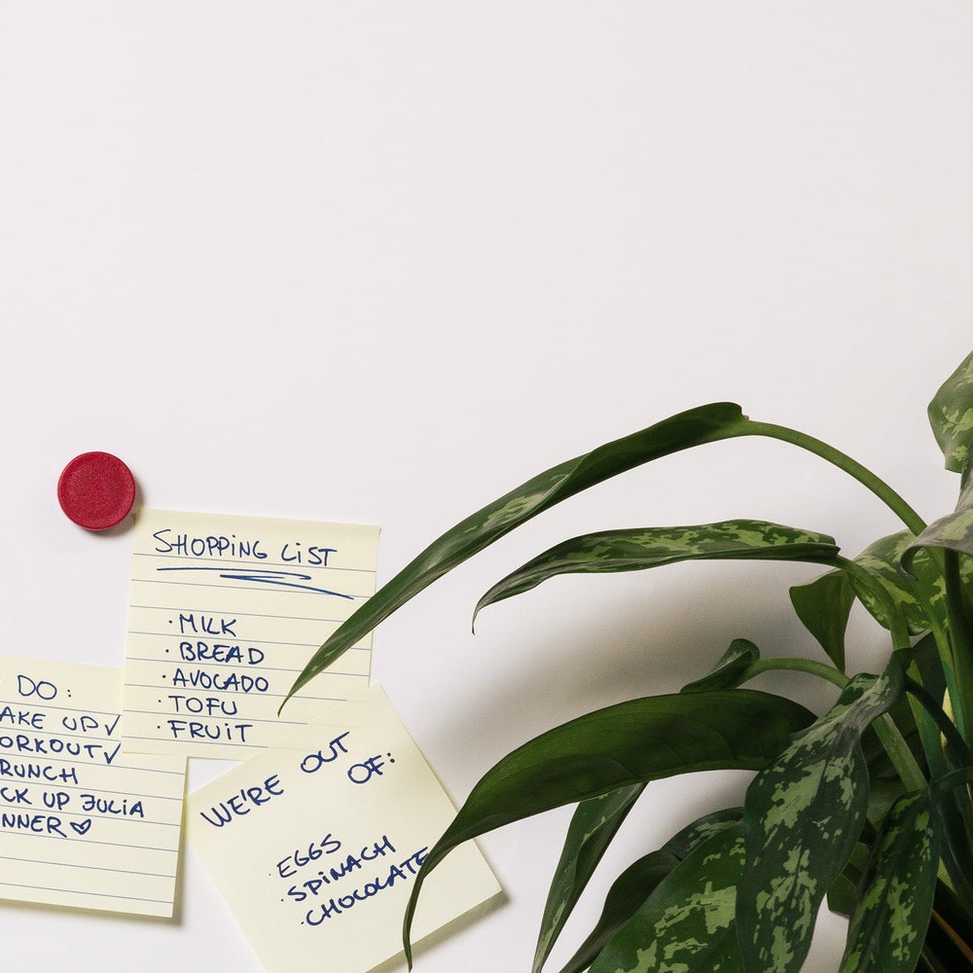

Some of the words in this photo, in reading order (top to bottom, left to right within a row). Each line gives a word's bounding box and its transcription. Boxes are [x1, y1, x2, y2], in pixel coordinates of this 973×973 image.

[179, 612, 236, 639] MILK
[180, 641, 264, 665] BREAD
[173, 668, 269, 694] AVOCADO
[168, 696, 237, 719] TOFU
[62, 716, 98, 732] UP
[200, 775, 284, 827] WE'RE
[300, 732, 350, 773] OUT
[347, 753, 395, 784] OF:
[43, 792, 70, 813] UP
[277, 834, 341, 878] EGGS
